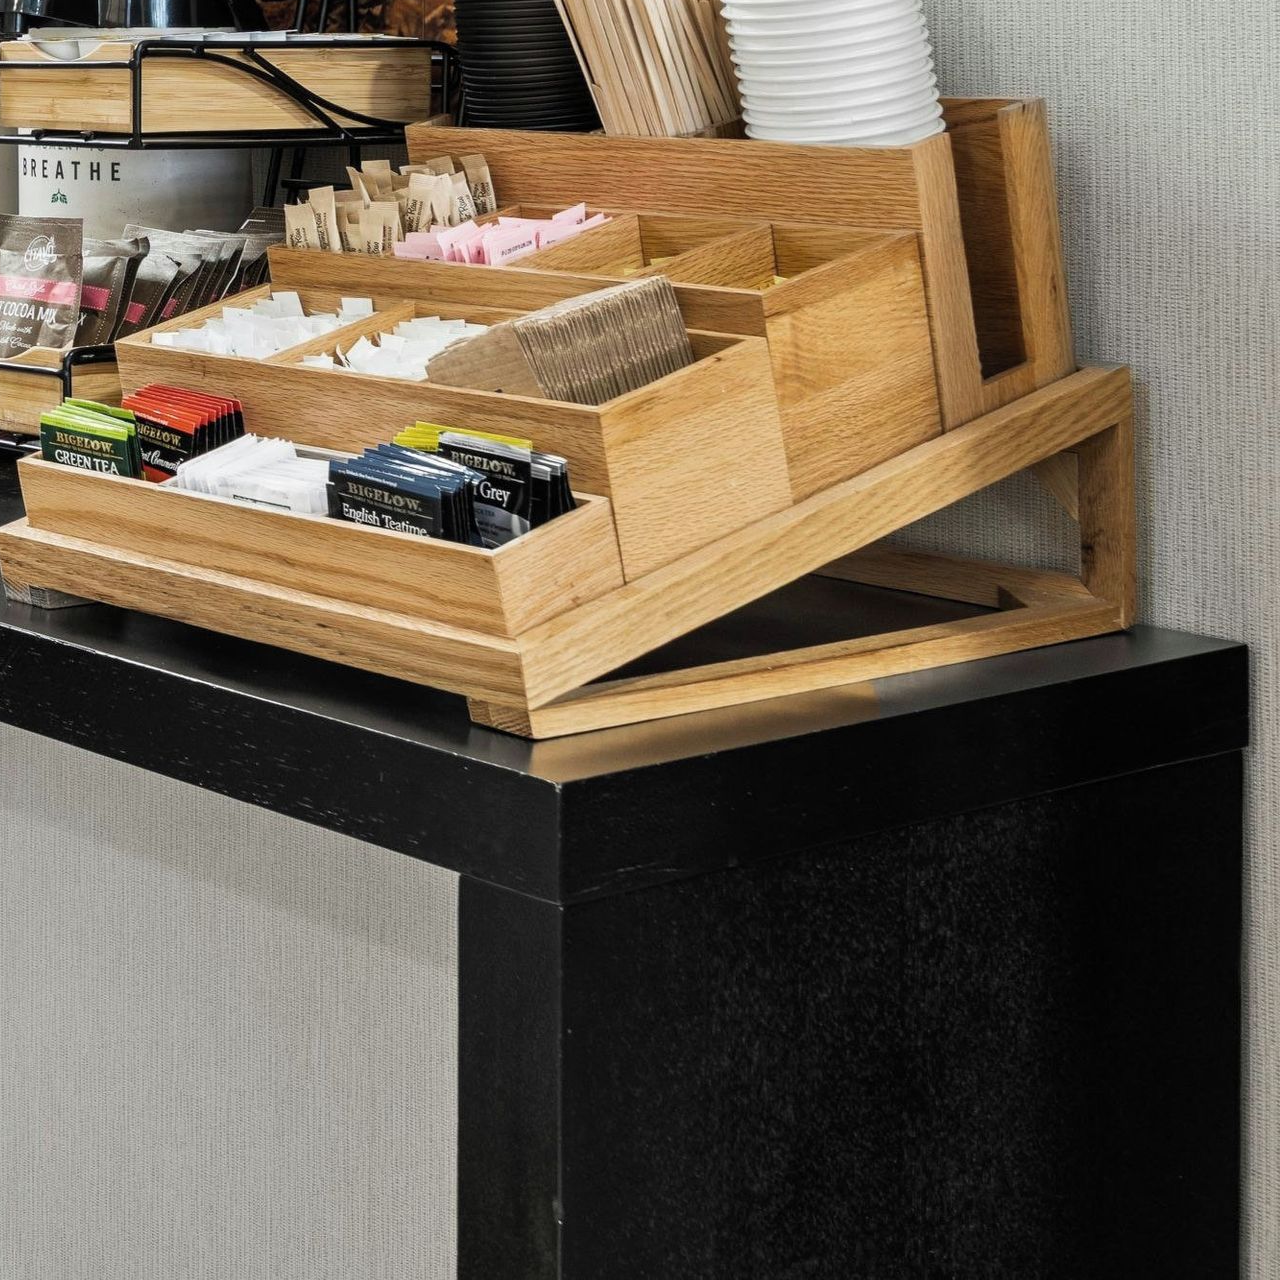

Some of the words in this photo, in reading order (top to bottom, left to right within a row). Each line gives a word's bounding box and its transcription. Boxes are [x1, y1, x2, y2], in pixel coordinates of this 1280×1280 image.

[23, 158, 121, 181] BREATHE
[3, 301, 35, 320] COCOA
[36, 307, 58, 324] MIX
[55, 449, 92, 470] GREEN
[93, 458, 119, 476] TEA
[480, 481, 511, 508] Grey
[342, 503, 380, 526] English
